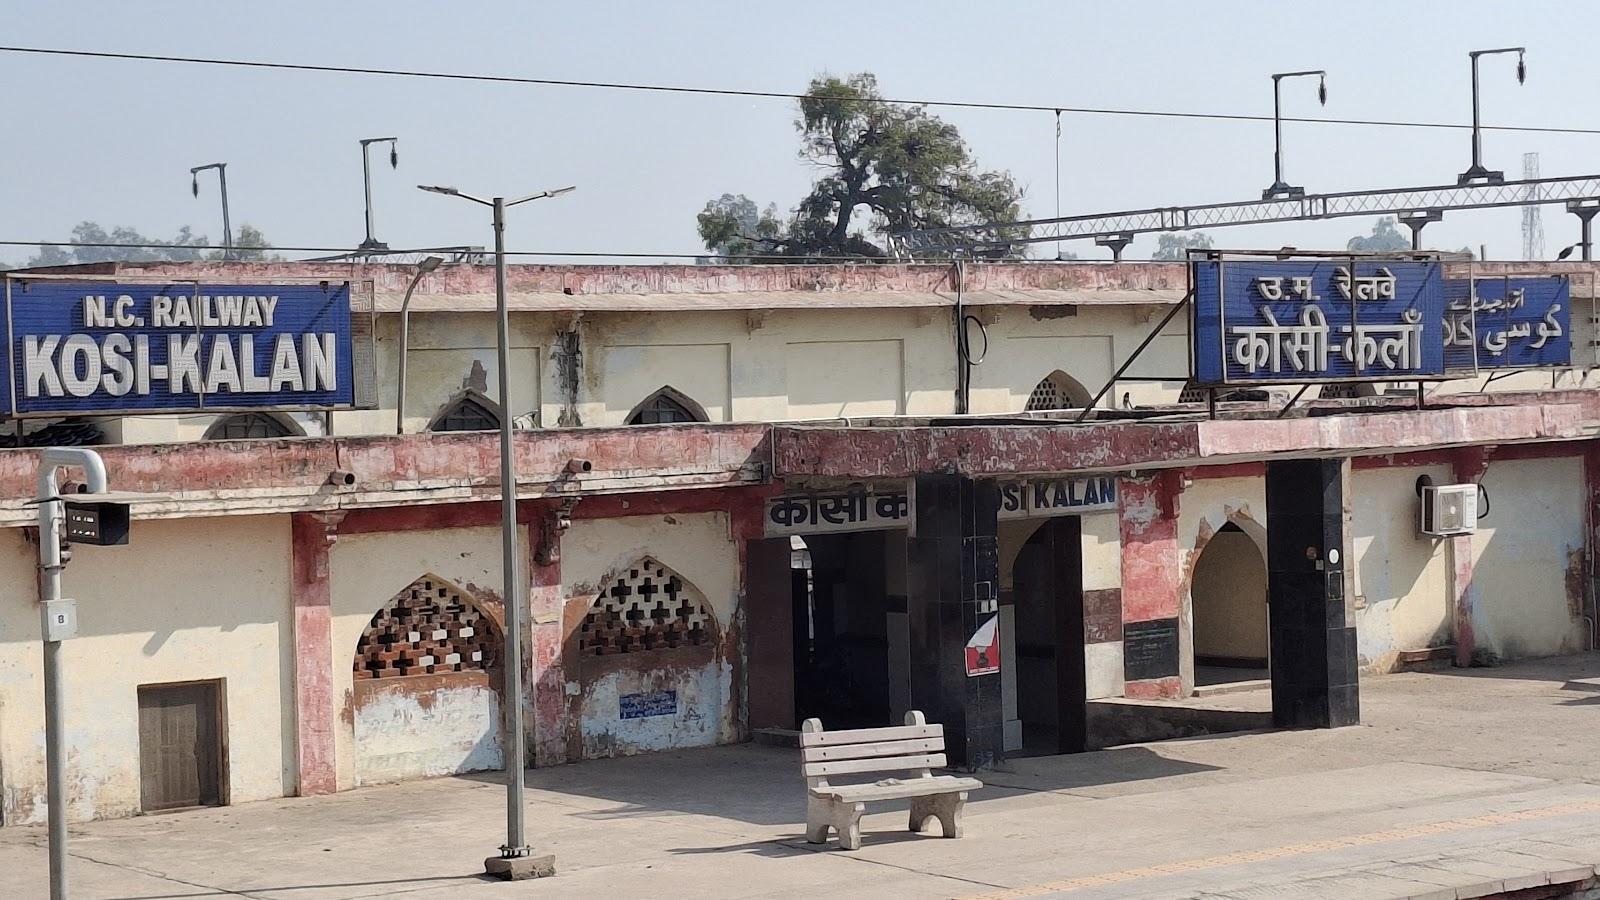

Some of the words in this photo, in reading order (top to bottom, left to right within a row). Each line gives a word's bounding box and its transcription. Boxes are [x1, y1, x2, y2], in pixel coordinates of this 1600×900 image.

[1335, 266, 1397, 301] रेलवे
[85, 295, 145, 327] N.C.
[153, 295, 279, 327] RAILWAY
[22, 332, 337, 397] KOSI-KALAN
[875, 493, 907, 519] क
[996, 482, 1027, 512] SI
[1034, 477, 1116, 508] KALAN
